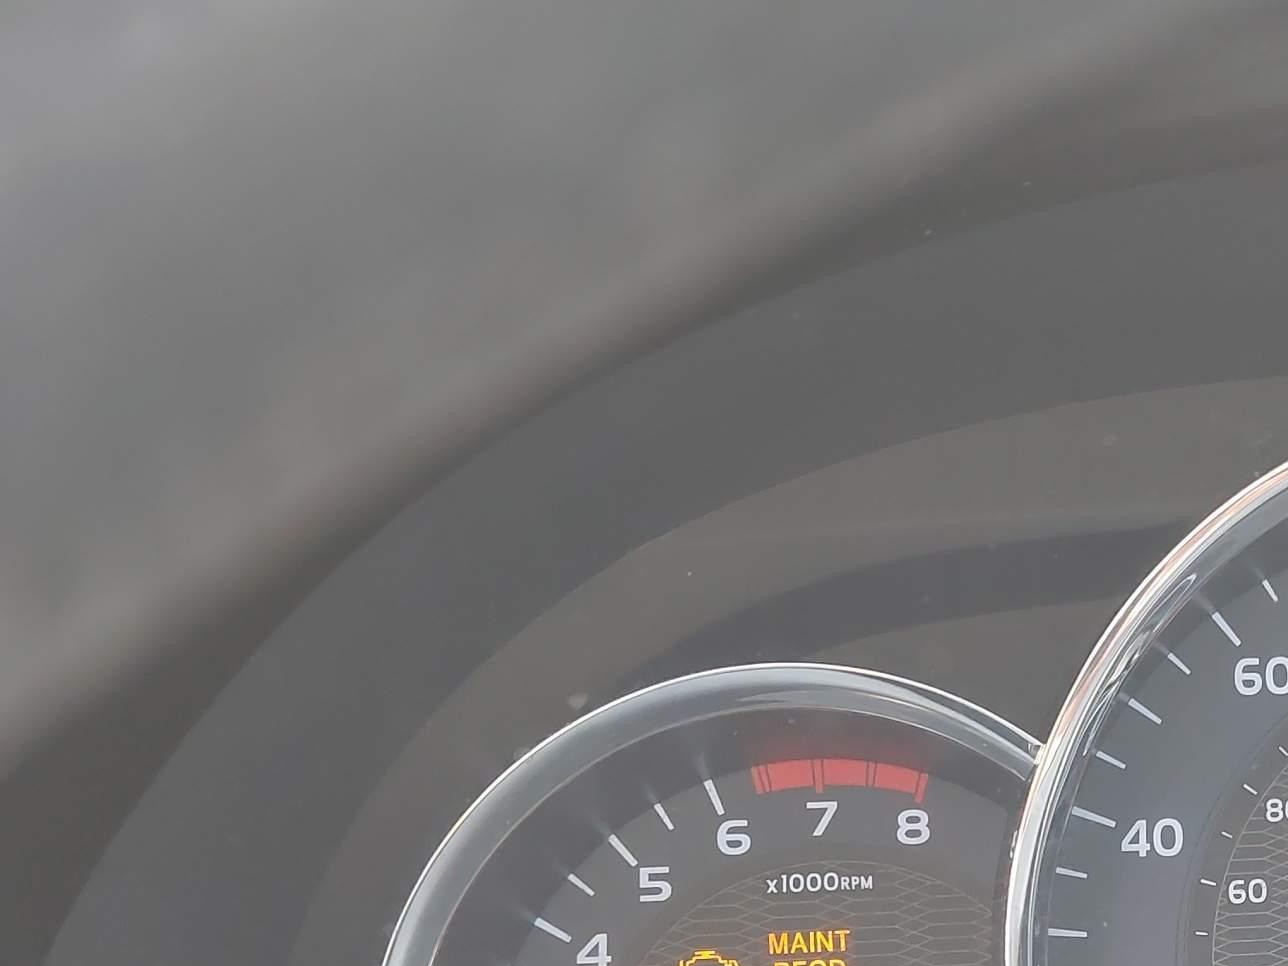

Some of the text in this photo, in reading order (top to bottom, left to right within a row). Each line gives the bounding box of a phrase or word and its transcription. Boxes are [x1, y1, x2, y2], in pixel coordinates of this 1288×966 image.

[806, 801, 838, 836] 7
[896, 809, 930, 844] 8
[717, 819, 752, 855] 6
[1121, 818, 1184, 857] 40
[639, 866, 672, 902] 5
[766, 872, 873, 894] x1000RPM
[1228, 878, 1268, 905] 60
[767, 929, 850, 955] MAINT
